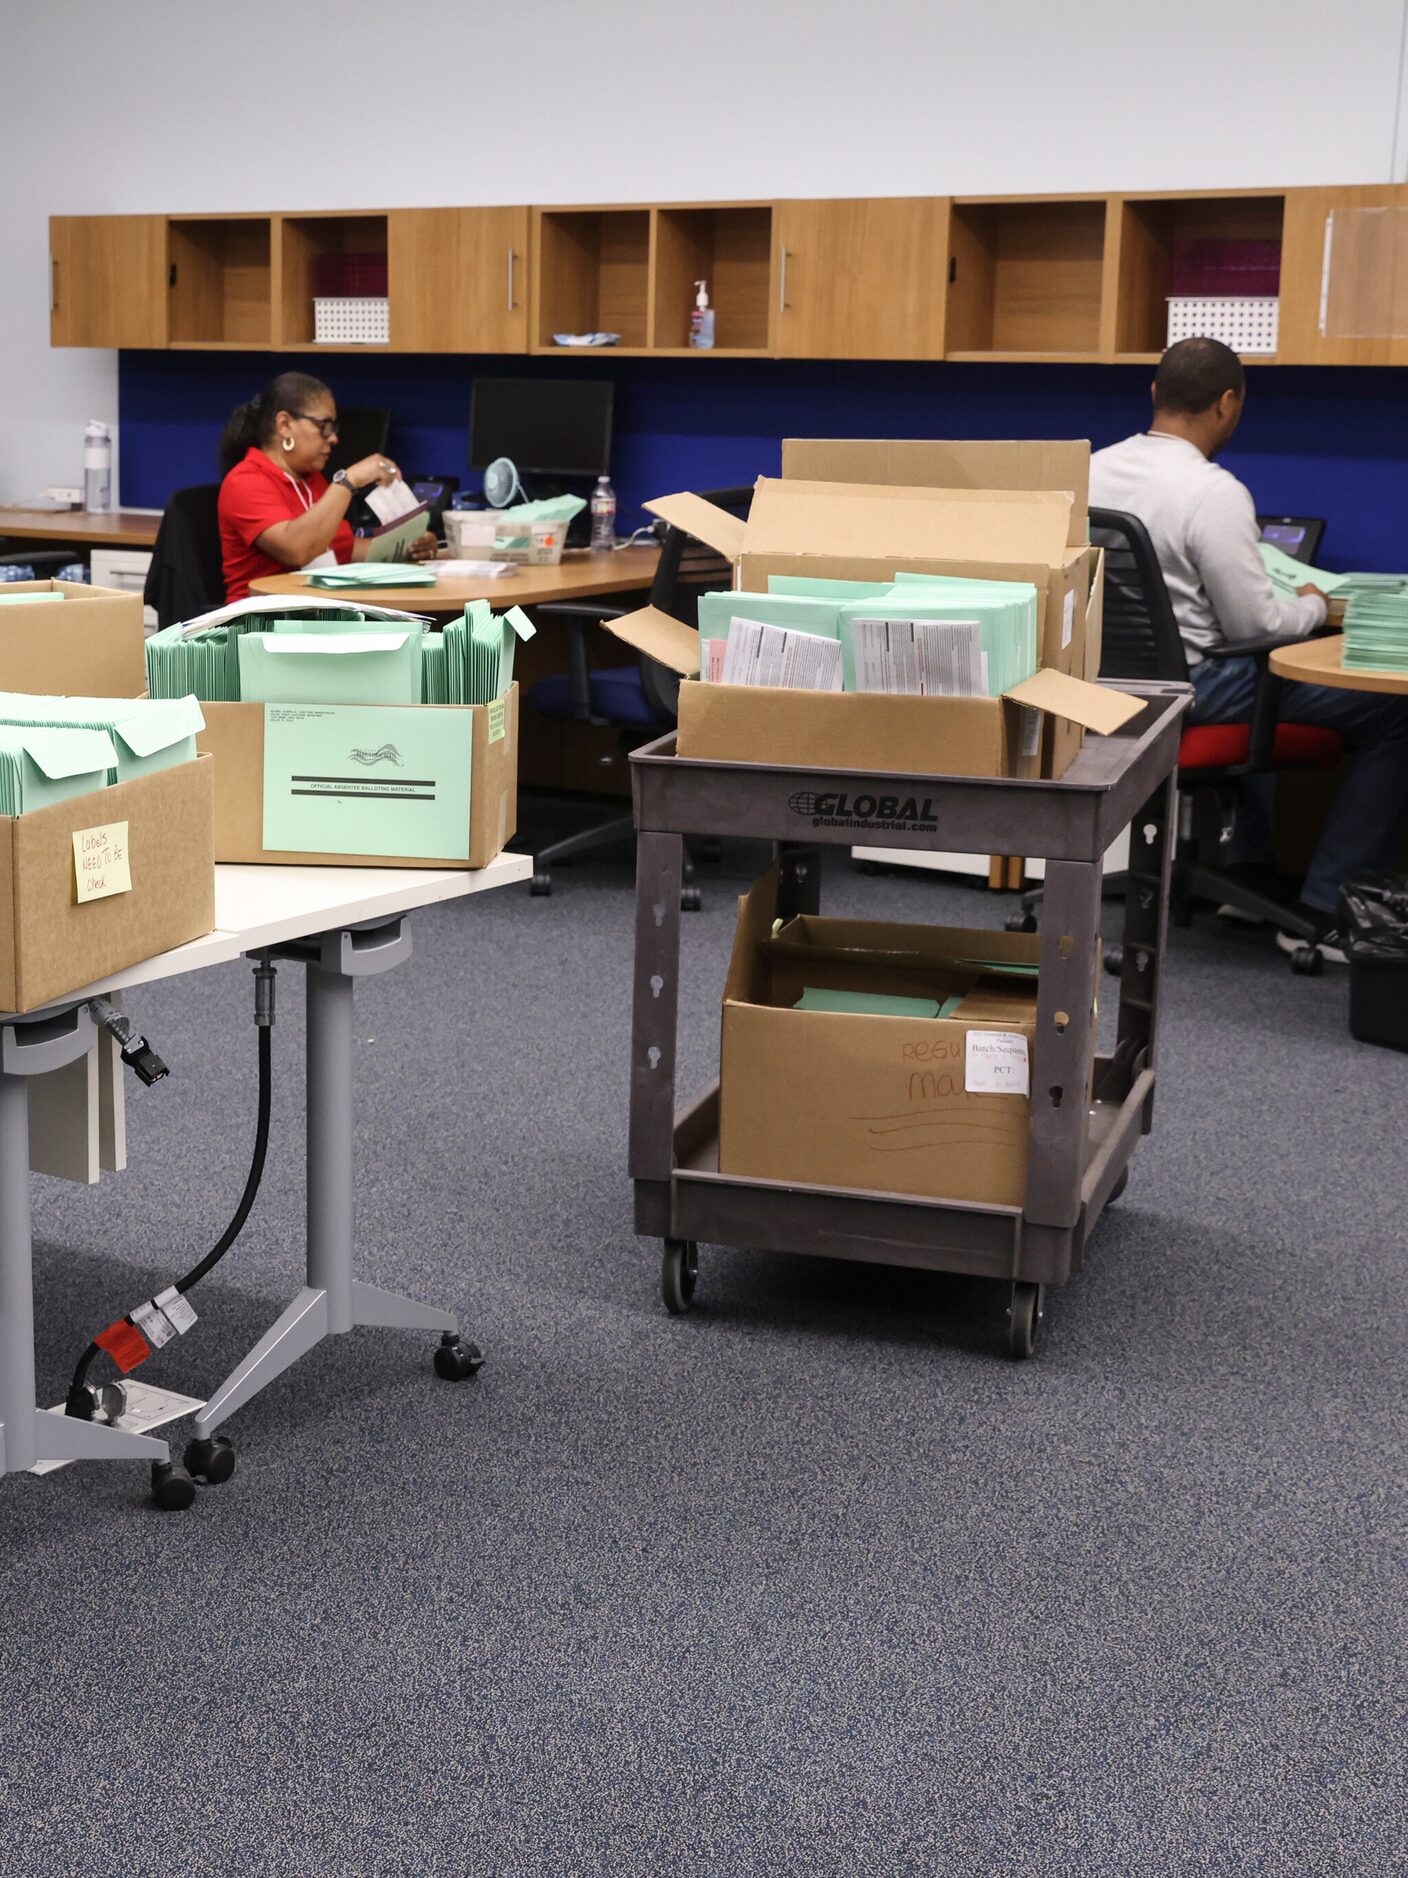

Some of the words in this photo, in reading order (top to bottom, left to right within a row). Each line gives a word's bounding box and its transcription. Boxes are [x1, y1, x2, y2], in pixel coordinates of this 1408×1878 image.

[814, 793, 939, 822] GLOBAL
[812, 816, 938, 833] globalindustrial.com
[972, 1044, 1026, 1056] Batch/Sequen
